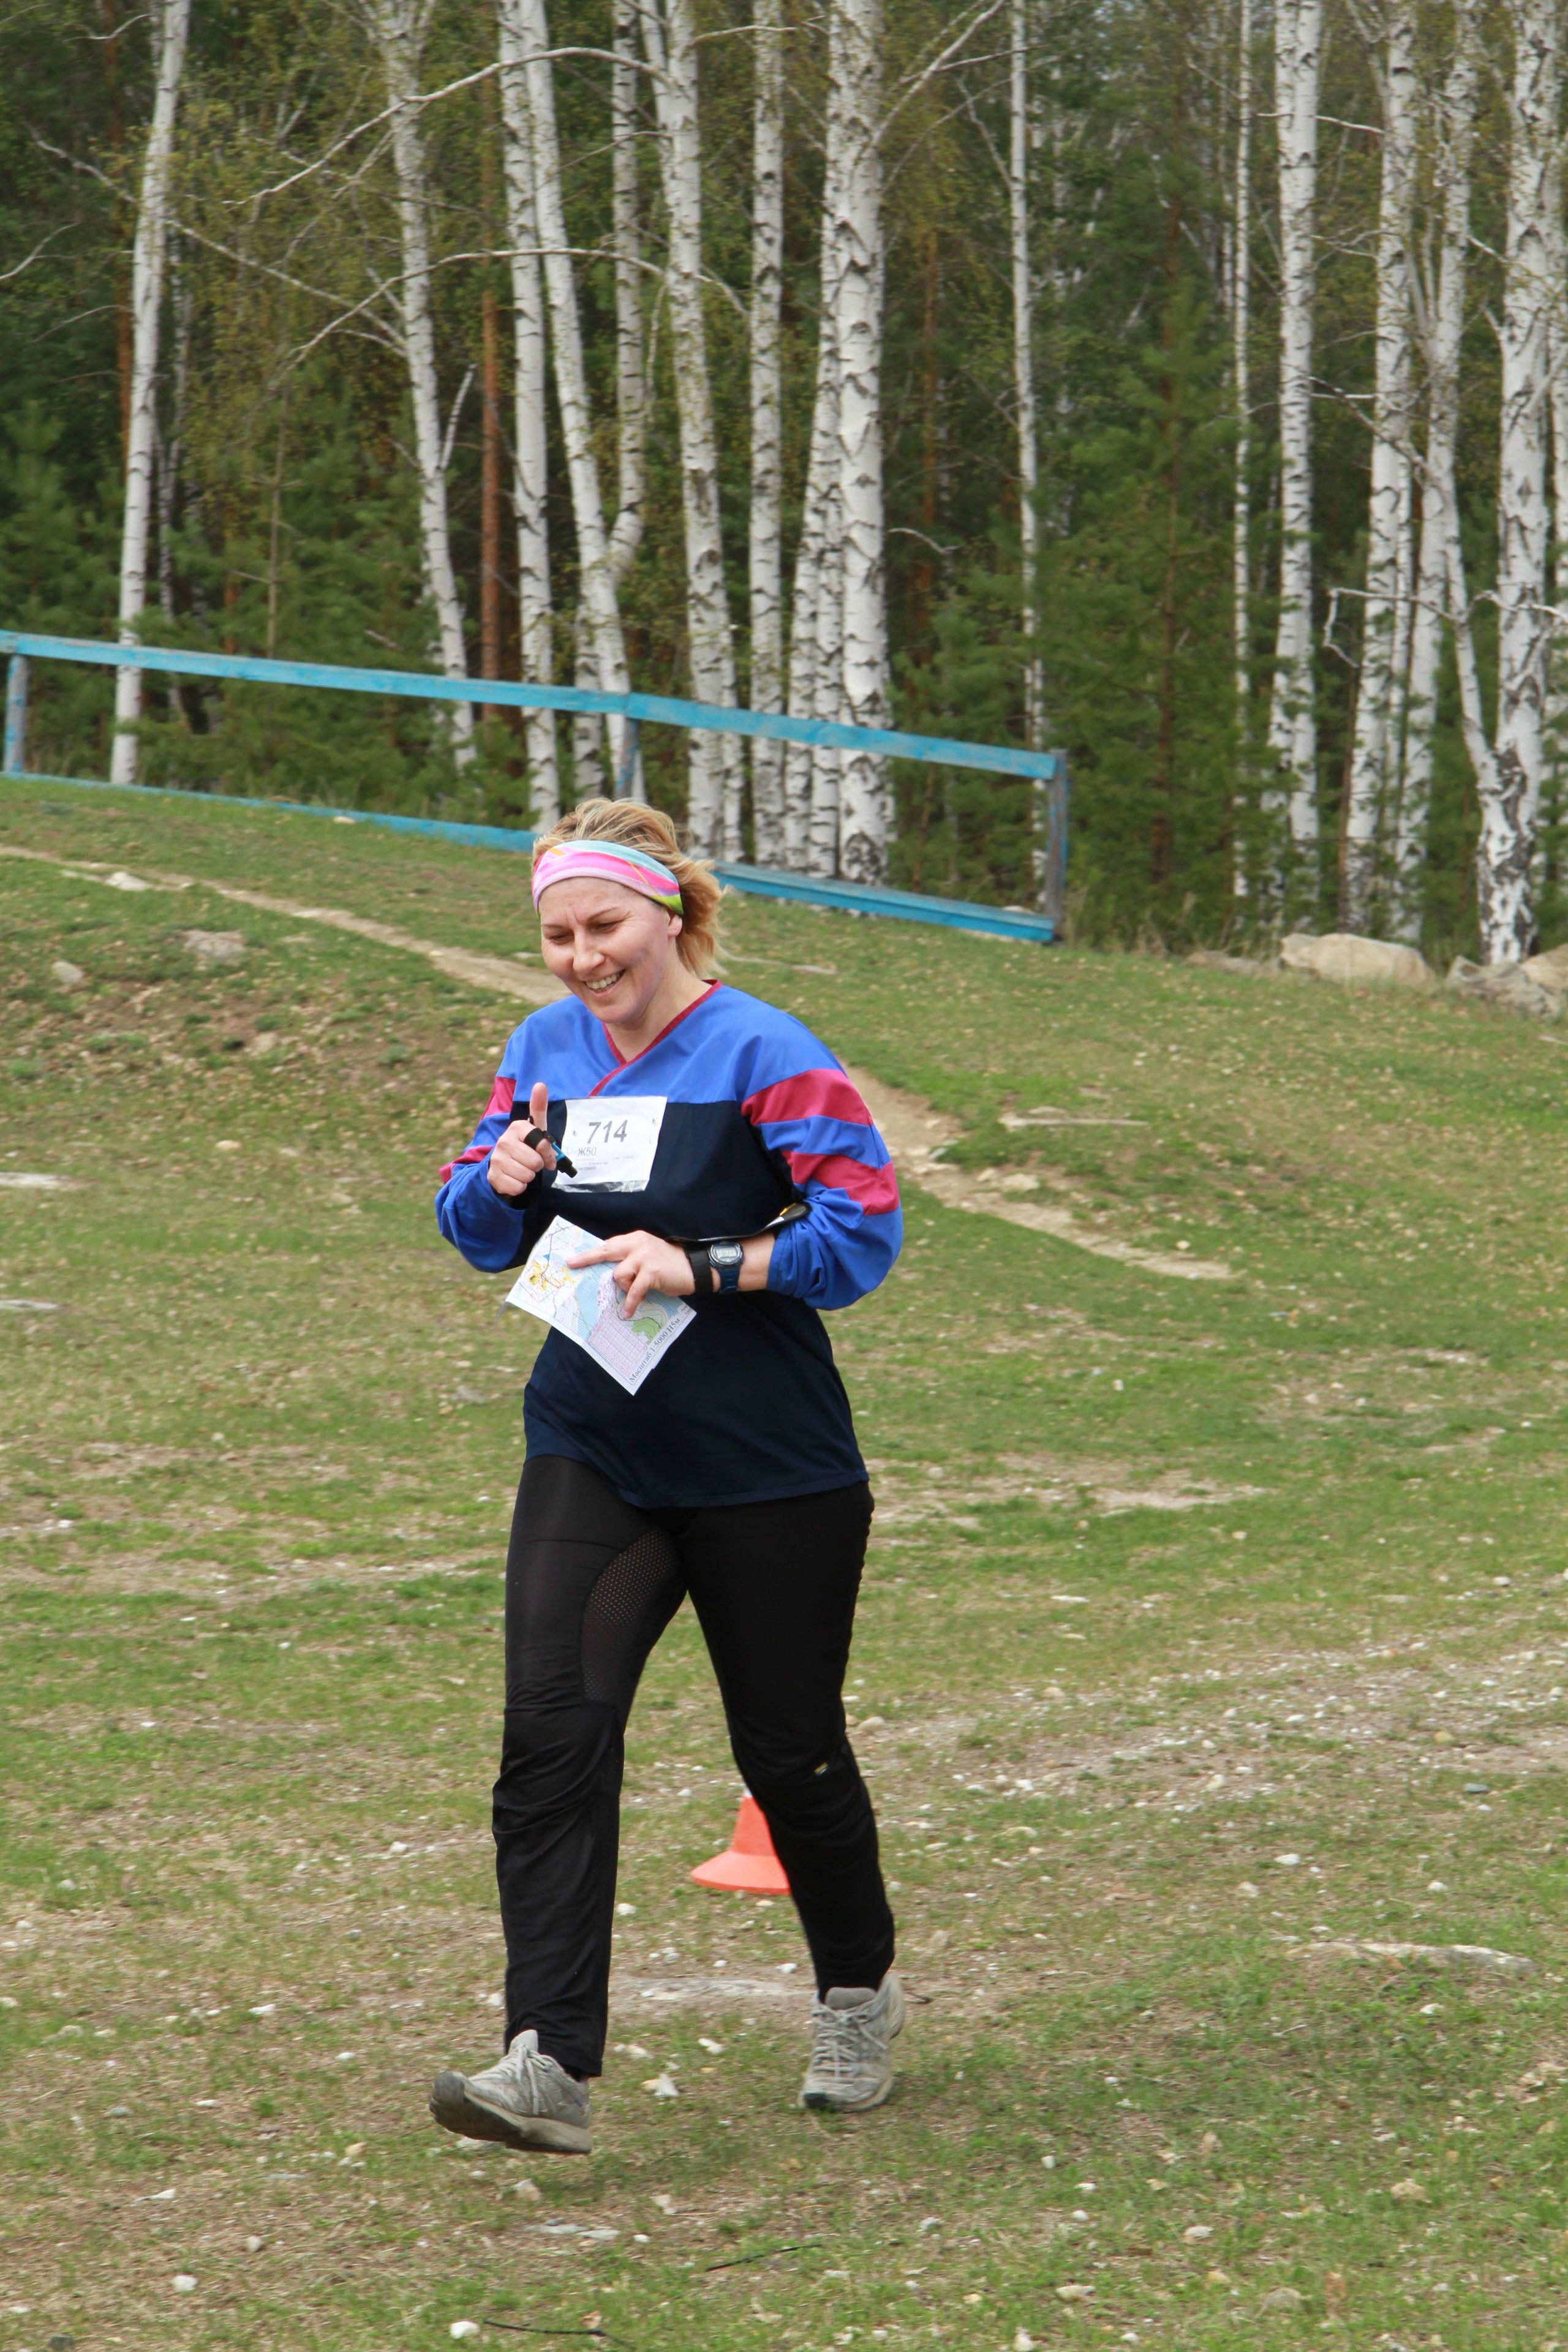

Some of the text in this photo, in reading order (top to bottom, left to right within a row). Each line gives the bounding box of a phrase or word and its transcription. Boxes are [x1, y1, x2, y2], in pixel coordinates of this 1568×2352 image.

[587, 1120, 628, 1144] 714
[578, 1147, 597, 1156] Ж50
[629, 1352, 652, 1382] Масштаб
[650, 1331, 668, 1352] 1:5000
